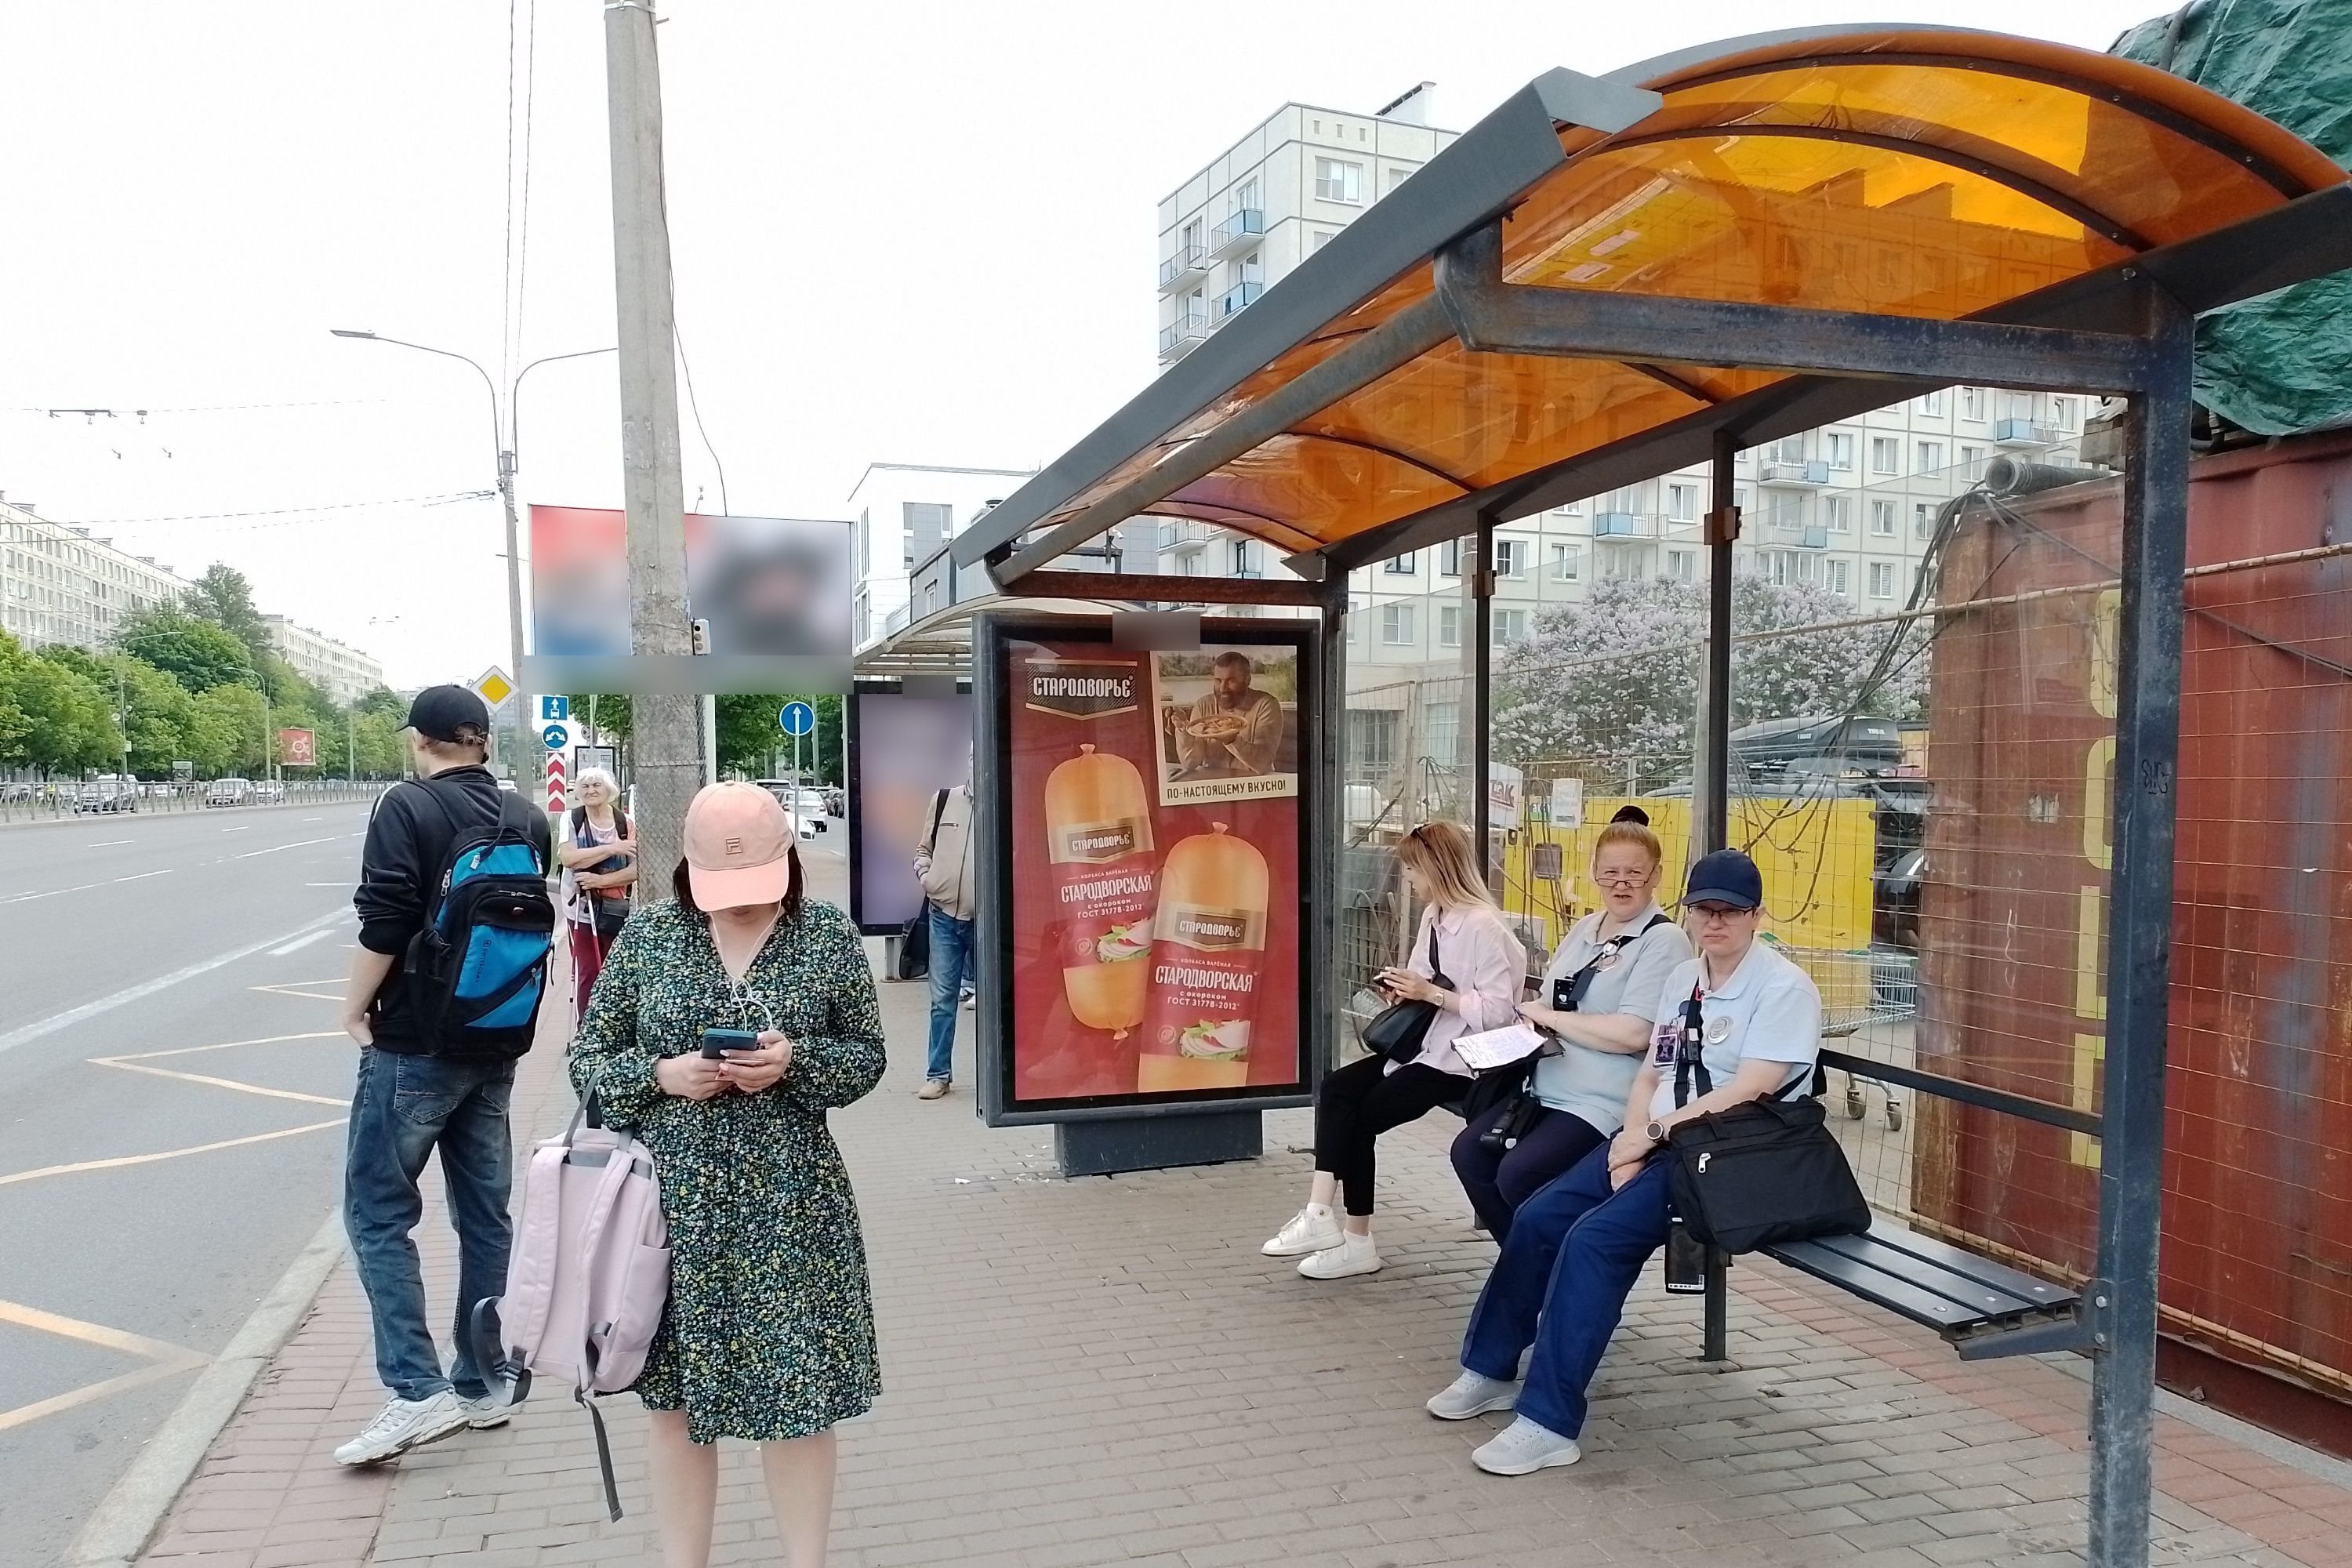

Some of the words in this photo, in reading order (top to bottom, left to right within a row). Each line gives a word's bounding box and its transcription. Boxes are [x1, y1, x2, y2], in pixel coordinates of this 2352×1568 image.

[1167, 783, 1246, 799] ПО-НАСТОЯЩЕМУ
[1247, 779, 1287, 793] ВКУСНО!
[1061, 874, 1152, 903] СТАРОДВОРСКАЯ
[1077, 909, 1099, 919] ГОСТ
[1101, 903, 1142, 916] 31778-2012
[1155, 965, 1253, 993] СТАРОДВОРСКАЯ
[1167, 996, 1190, 1006] ГОСТ
[1192, 1000, 1236, 1011] 31778-2012
